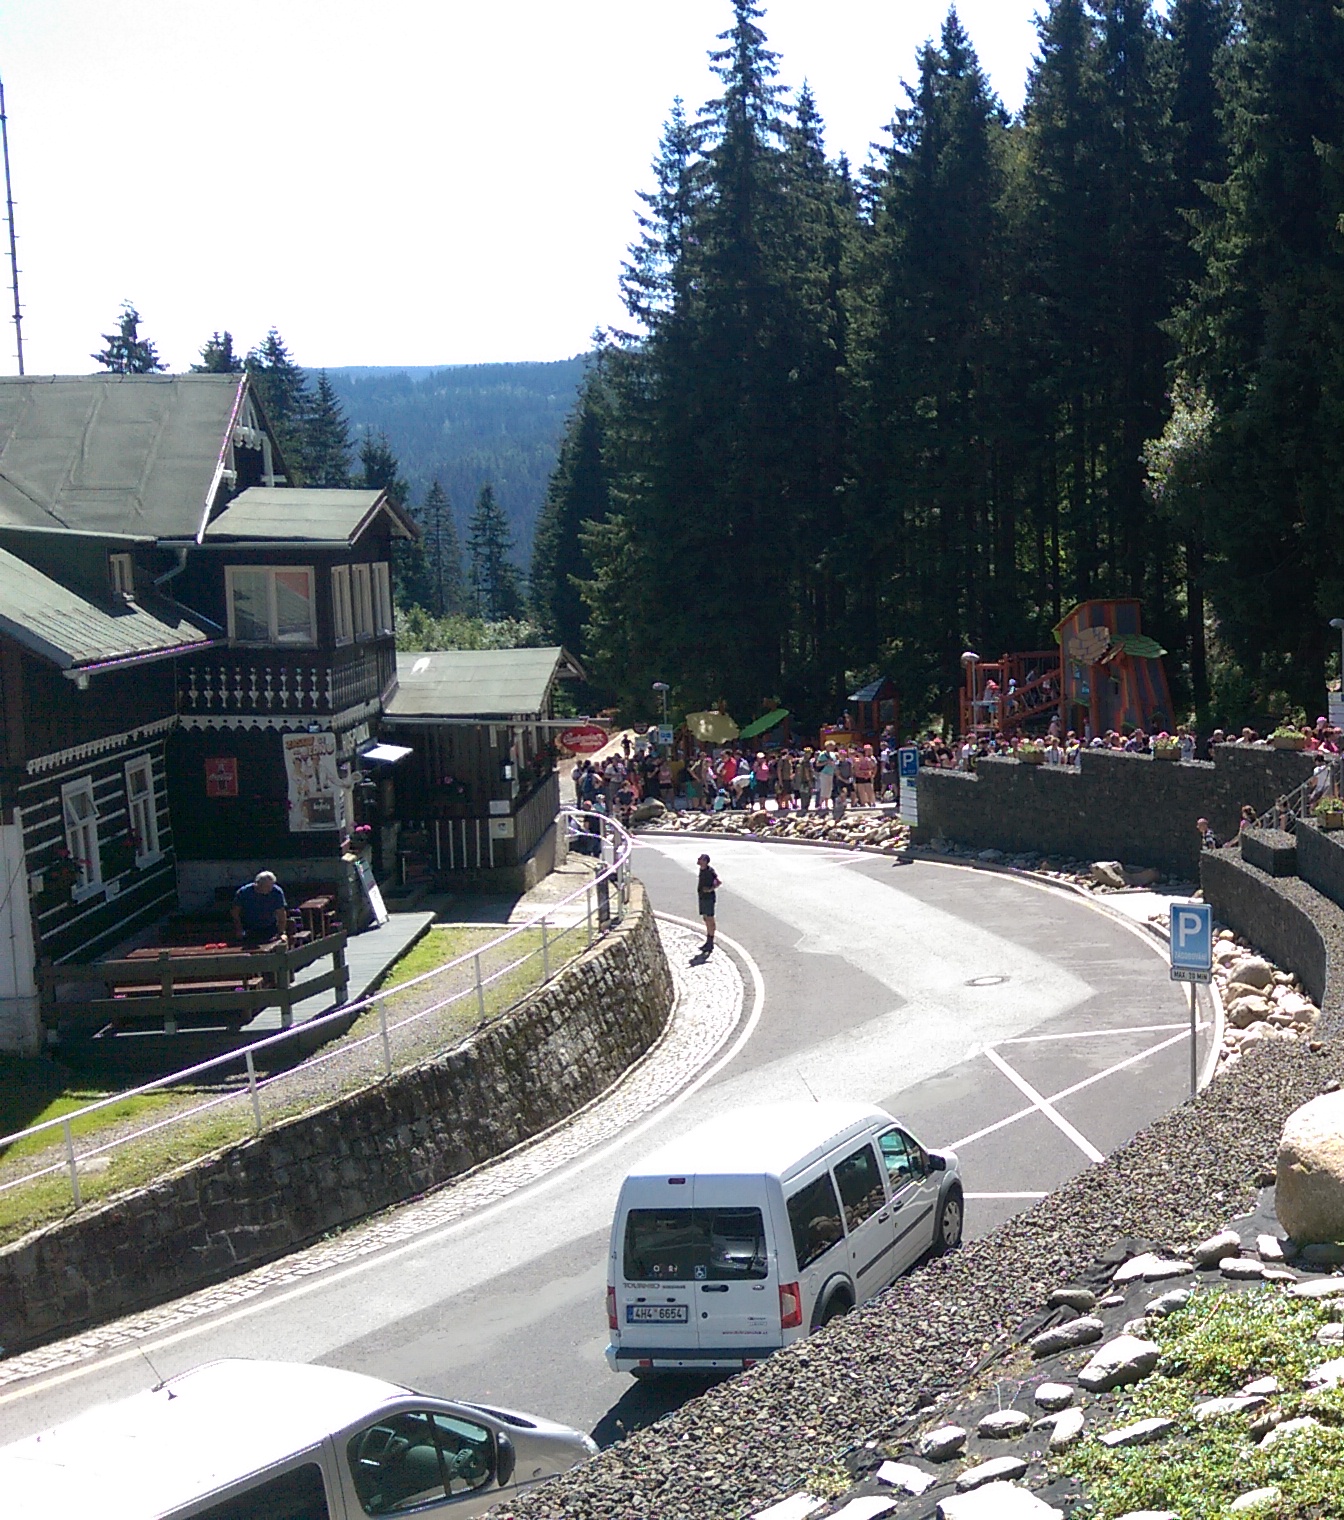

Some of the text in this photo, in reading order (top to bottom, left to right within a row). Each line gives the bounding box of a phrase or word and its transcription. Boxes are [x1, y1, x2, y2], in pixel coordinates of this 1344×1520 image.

[902, 752, 914, 768] P
[1179, 912, 1202, 947] P
[635, 1308, 682, 1319] 4H4 6654
